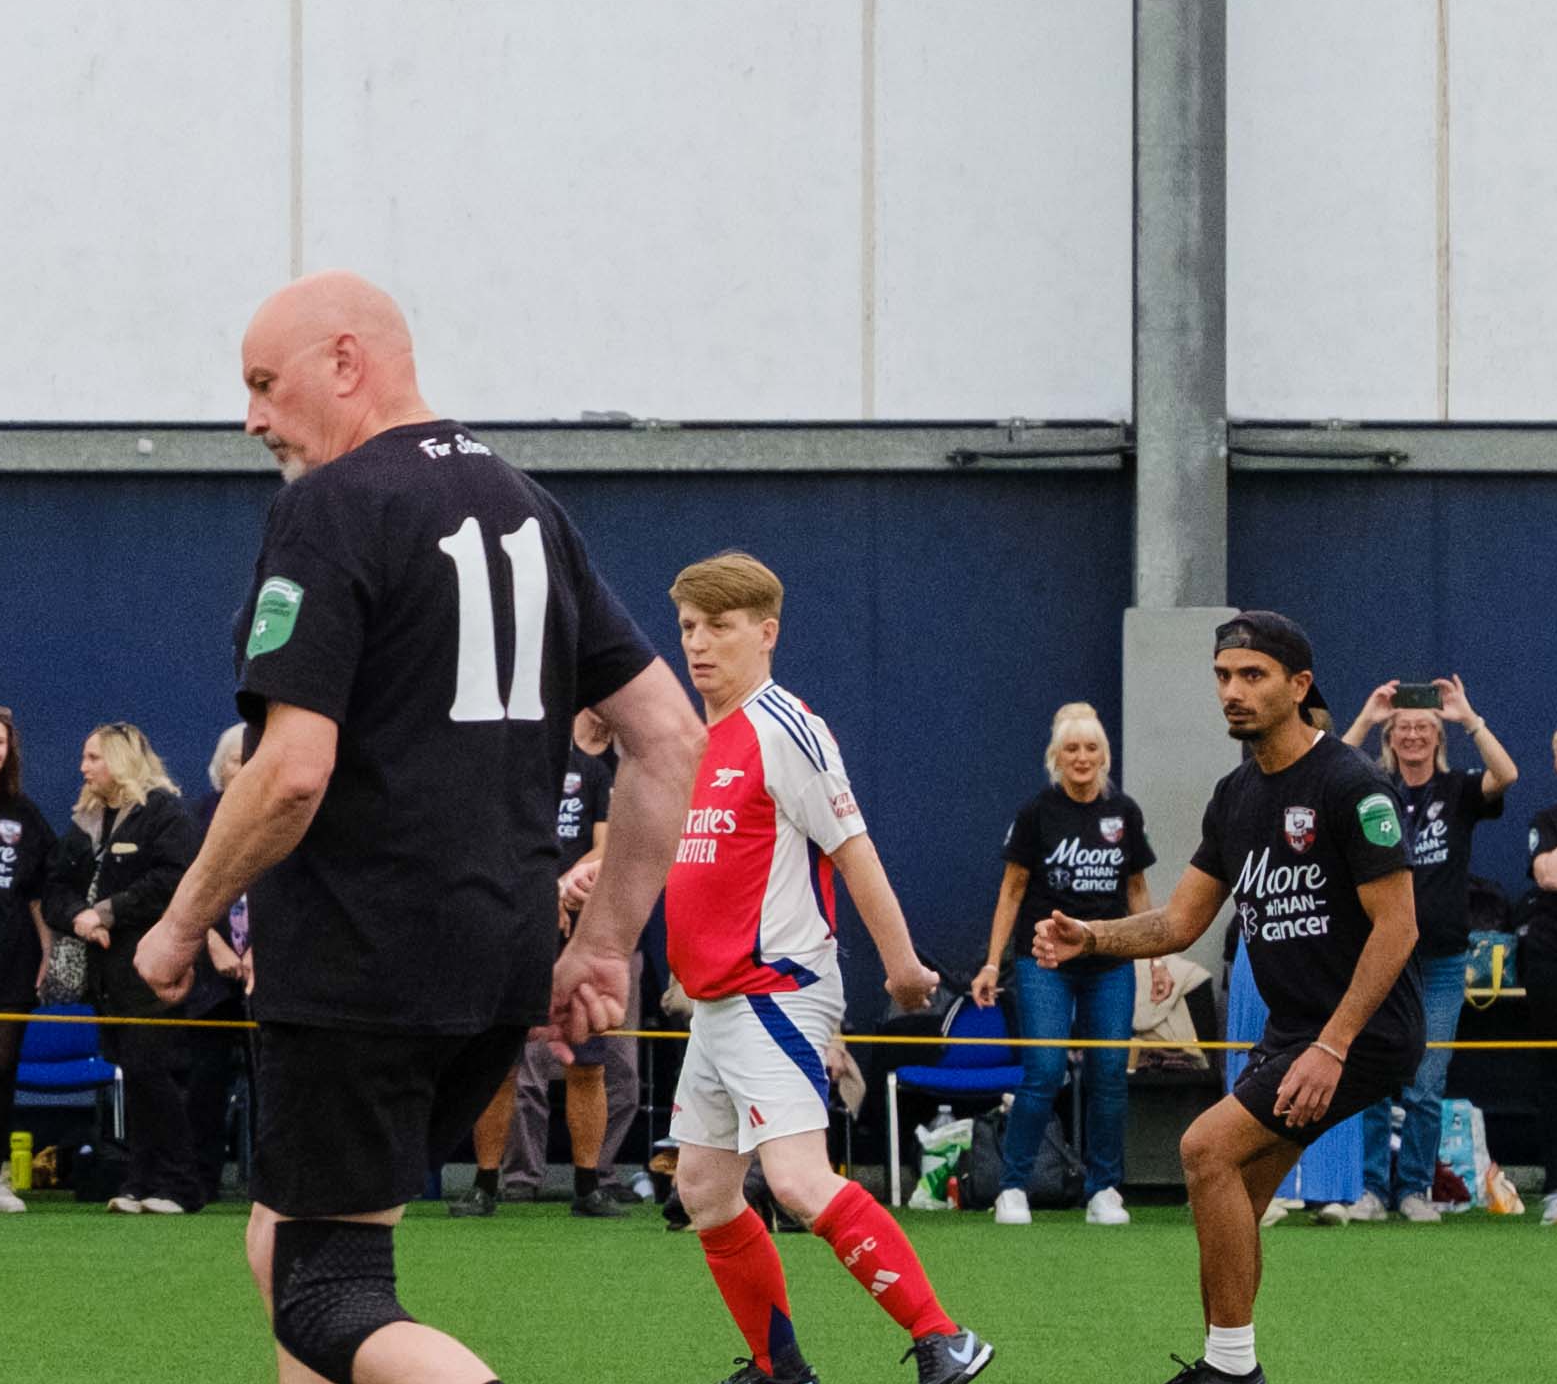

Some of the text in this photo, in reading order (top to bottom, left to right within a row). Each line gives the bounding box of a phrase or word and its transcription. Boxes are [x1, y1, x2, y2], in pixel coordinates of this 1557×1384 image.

[438, 516, 549, 722] 11
[685, 806, 737, 834] rates
[1044, 836, 1125, 867] Moore
[1072, 878, 1119, 892] cancer
[1261, 915, 1330, 942] cancer
[843, 1235, 877, 1267] AFC
